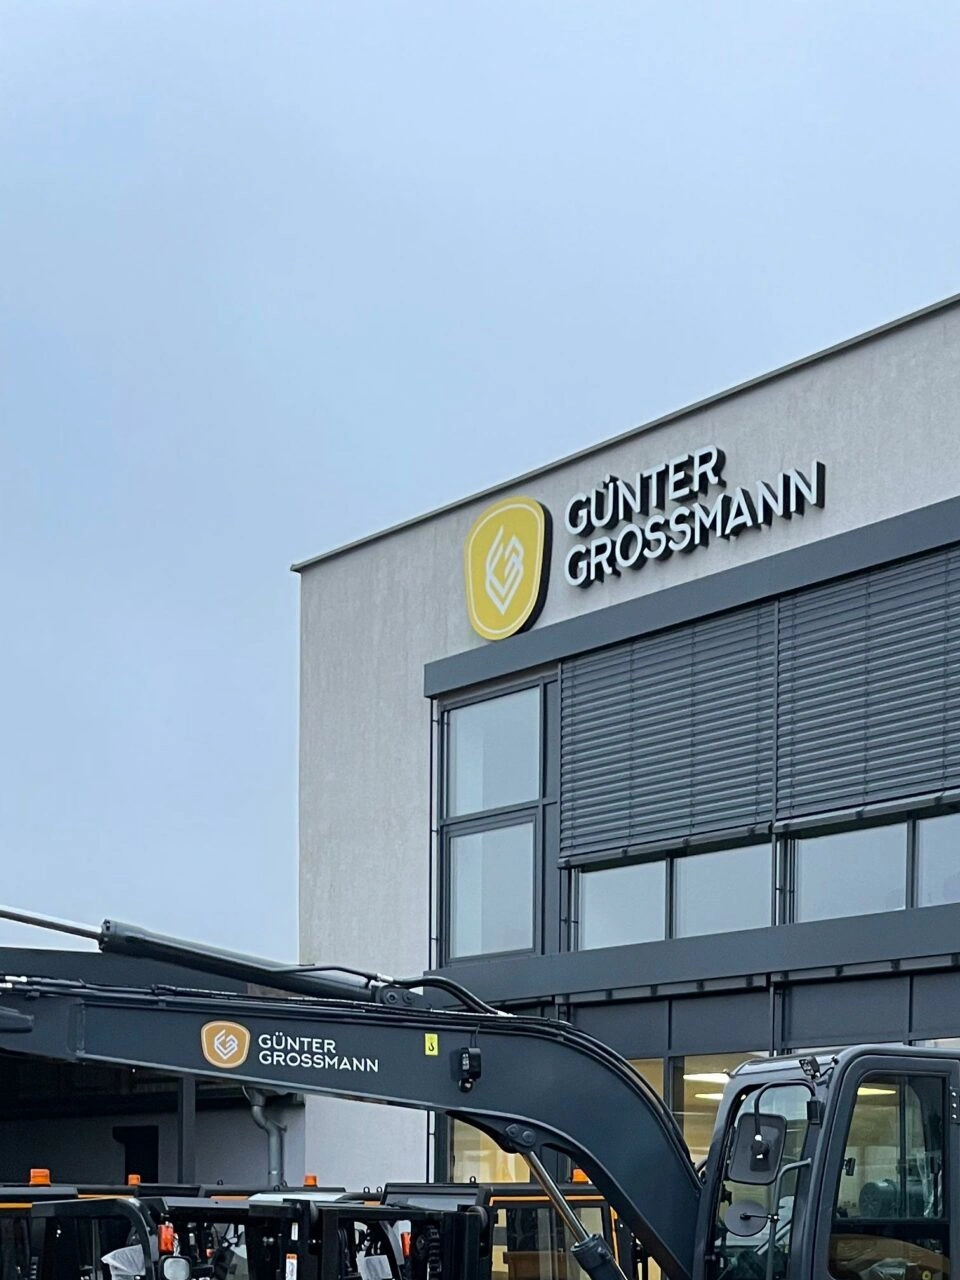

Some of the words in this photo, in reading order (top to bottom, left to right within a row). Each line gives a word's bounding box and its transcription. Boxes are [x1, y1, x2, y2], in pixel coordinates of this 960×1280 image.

[564, 445, 723, 535] GÜNTER
[564, 459, 822, 587] GROSSMANN
[258, 1031, 336, 1054] GÜNTER
[259, 1050, 379, 1073] GROSSMANN
